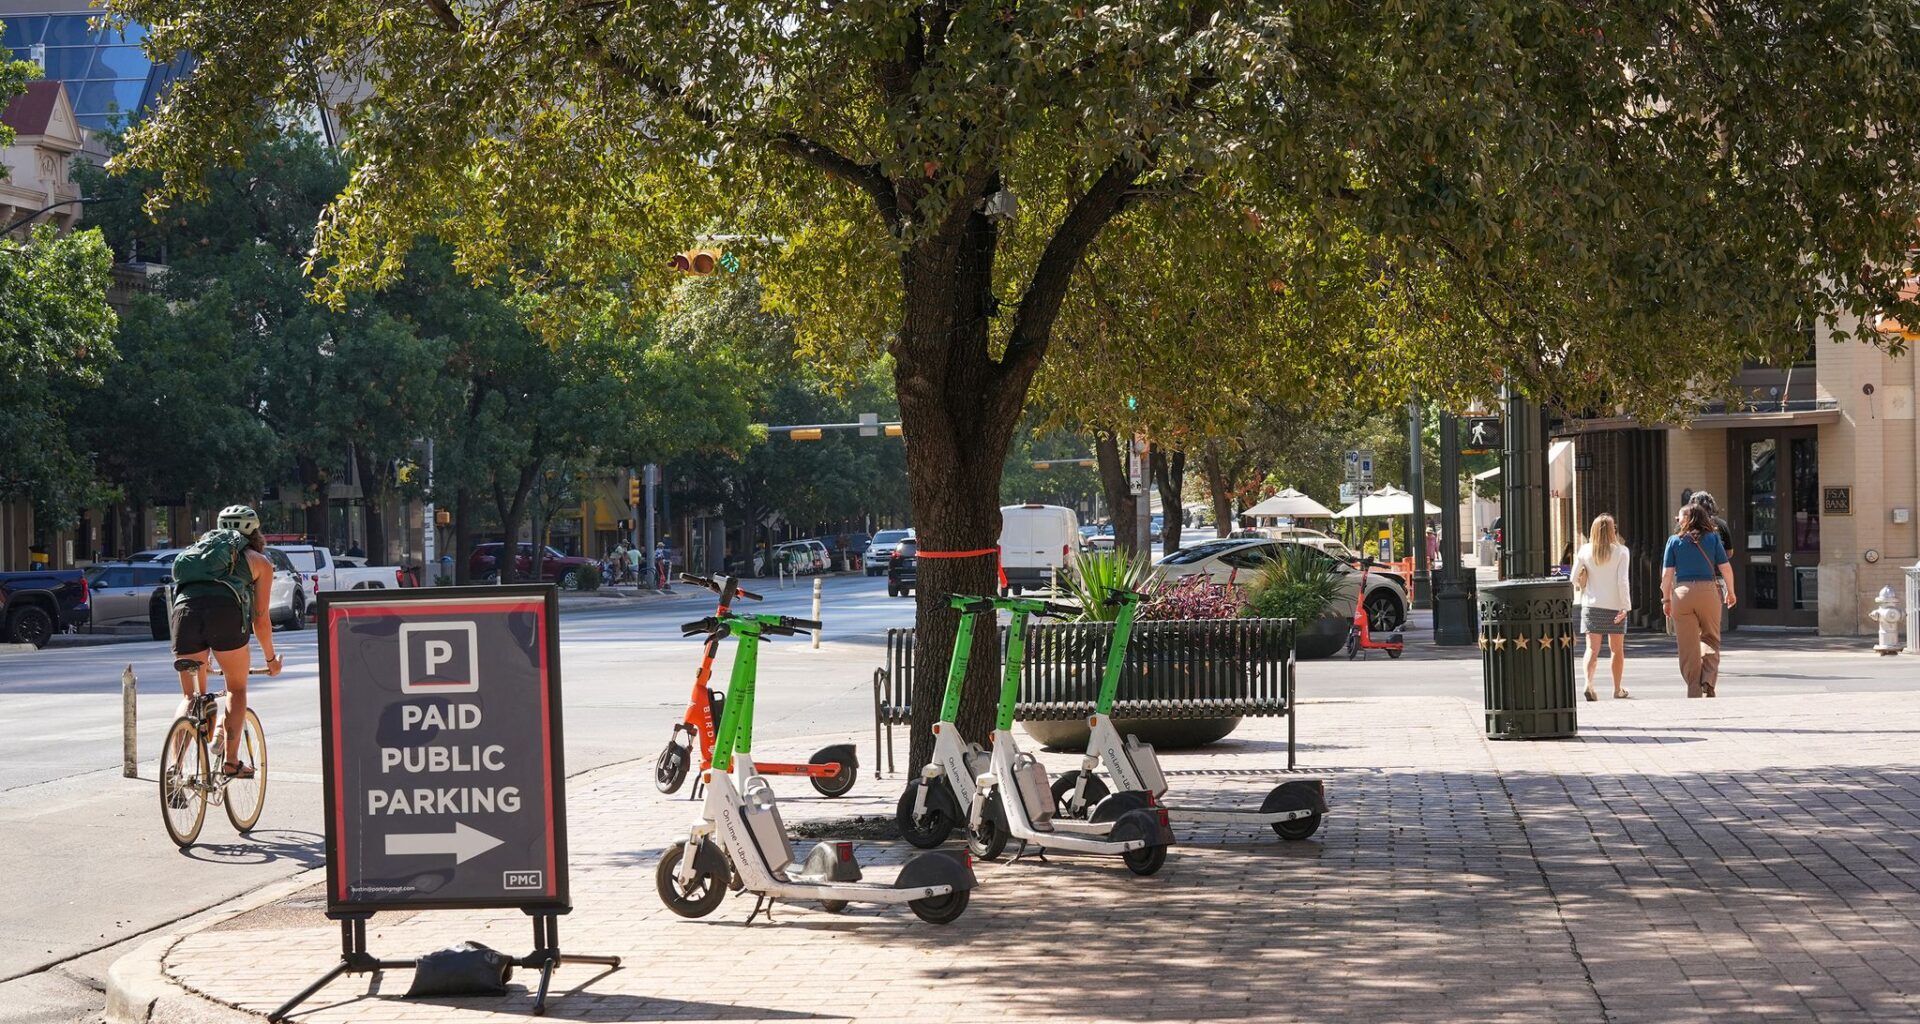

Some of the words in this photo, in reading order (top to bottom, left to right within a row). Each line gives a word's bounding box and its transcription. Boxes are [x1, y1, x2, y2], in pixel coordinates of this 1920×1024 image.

[1825, 500, 1848, 509] BANK
[425, 640, 452, 675] P
[402, 703, 482, 731] PAID
[703, 706, 714, 737] BIRD
[381, 744, 506, 773] PUBLIC
[368, 786, 521, 815] PARKING
[723, 809, 729, 821] On
[727, 822, 737, 841] Lime
[737, 847, 749, 867] Uber
[509, 875, 537, 885] PMC
